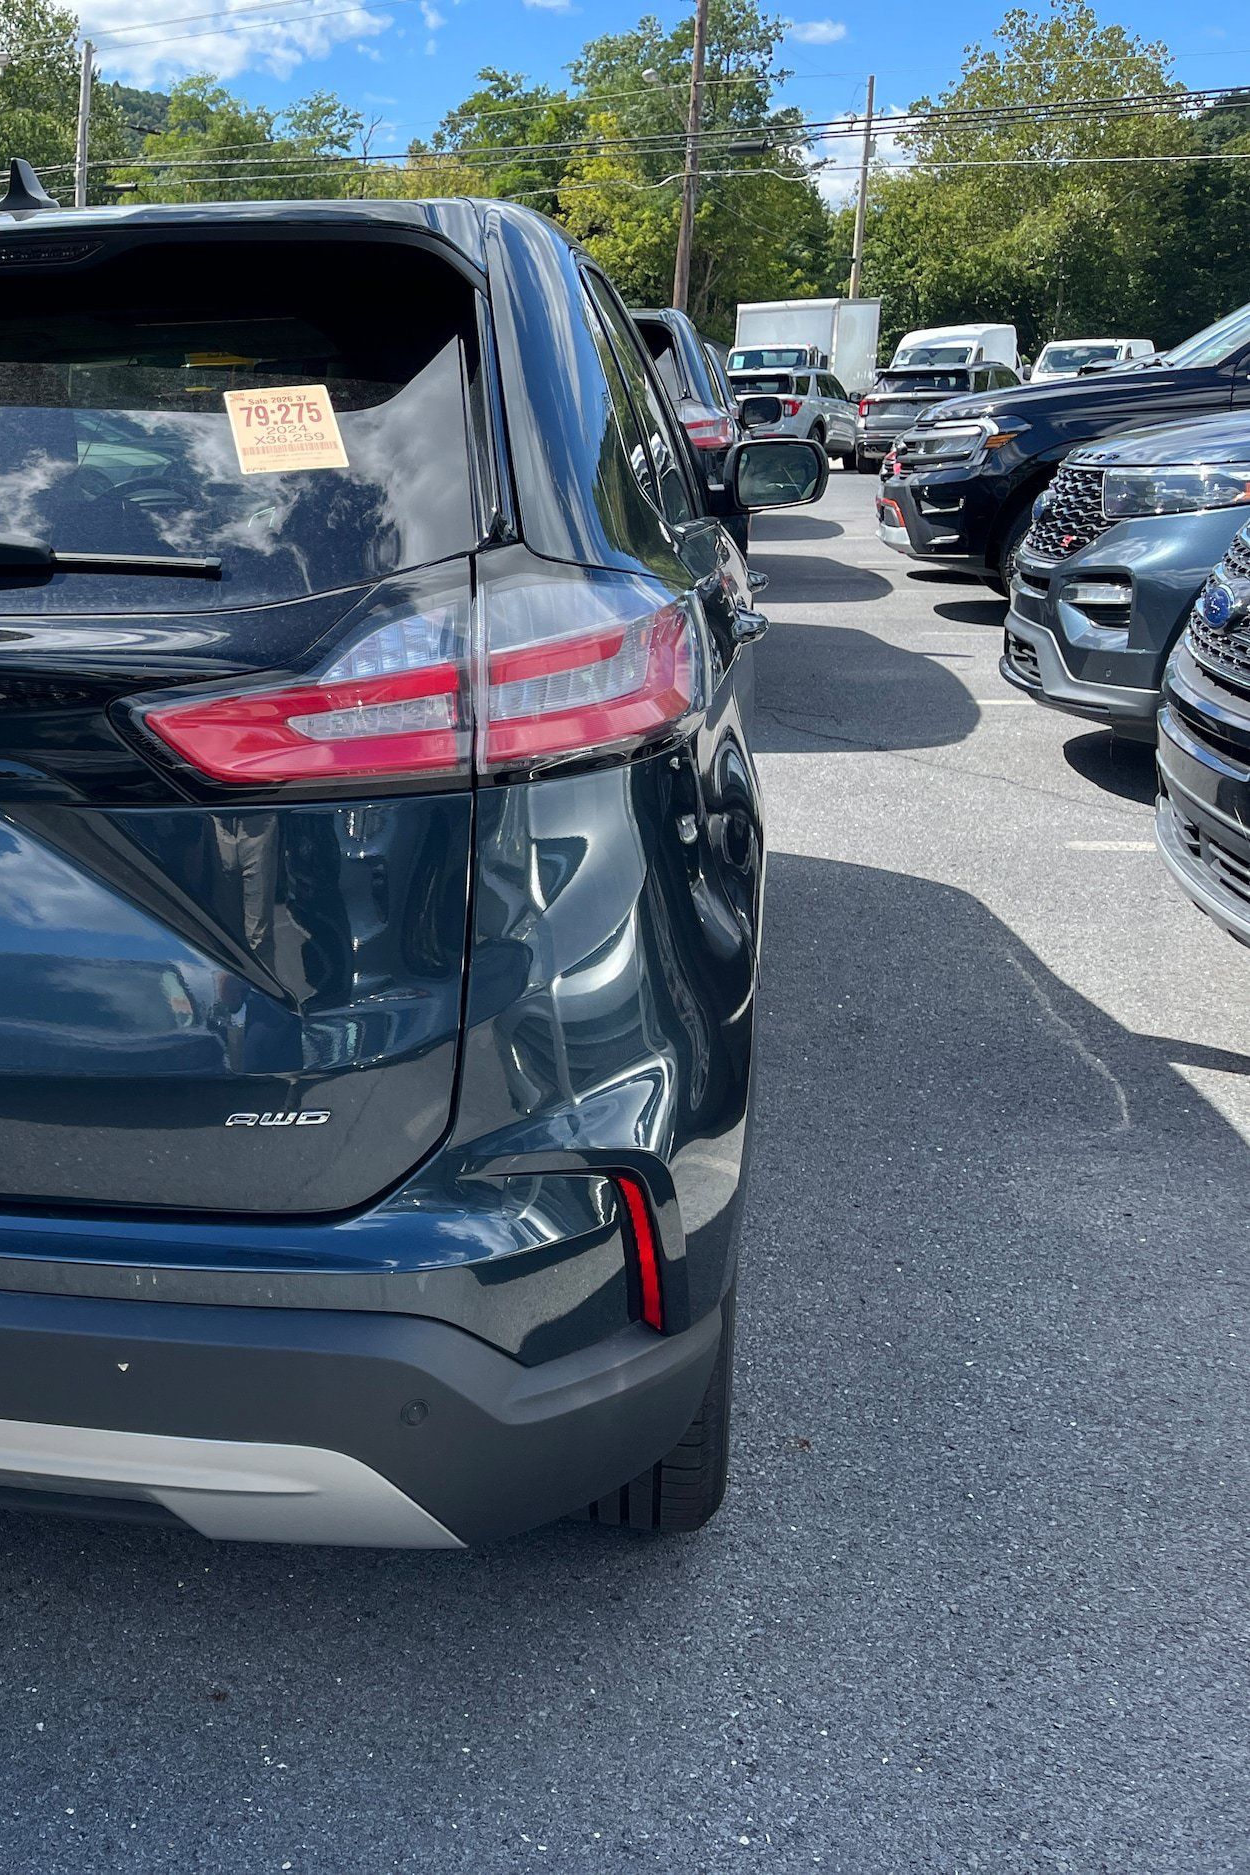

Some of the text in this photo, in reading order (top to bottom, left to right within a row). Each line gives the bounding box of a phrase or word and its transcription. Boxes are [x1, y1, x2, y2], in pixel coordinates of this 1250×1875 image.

[248, 397, 268, 406] Sale
[266, 424, 309, 436] 2024
[225, 1110, 331, 1127] AWD
